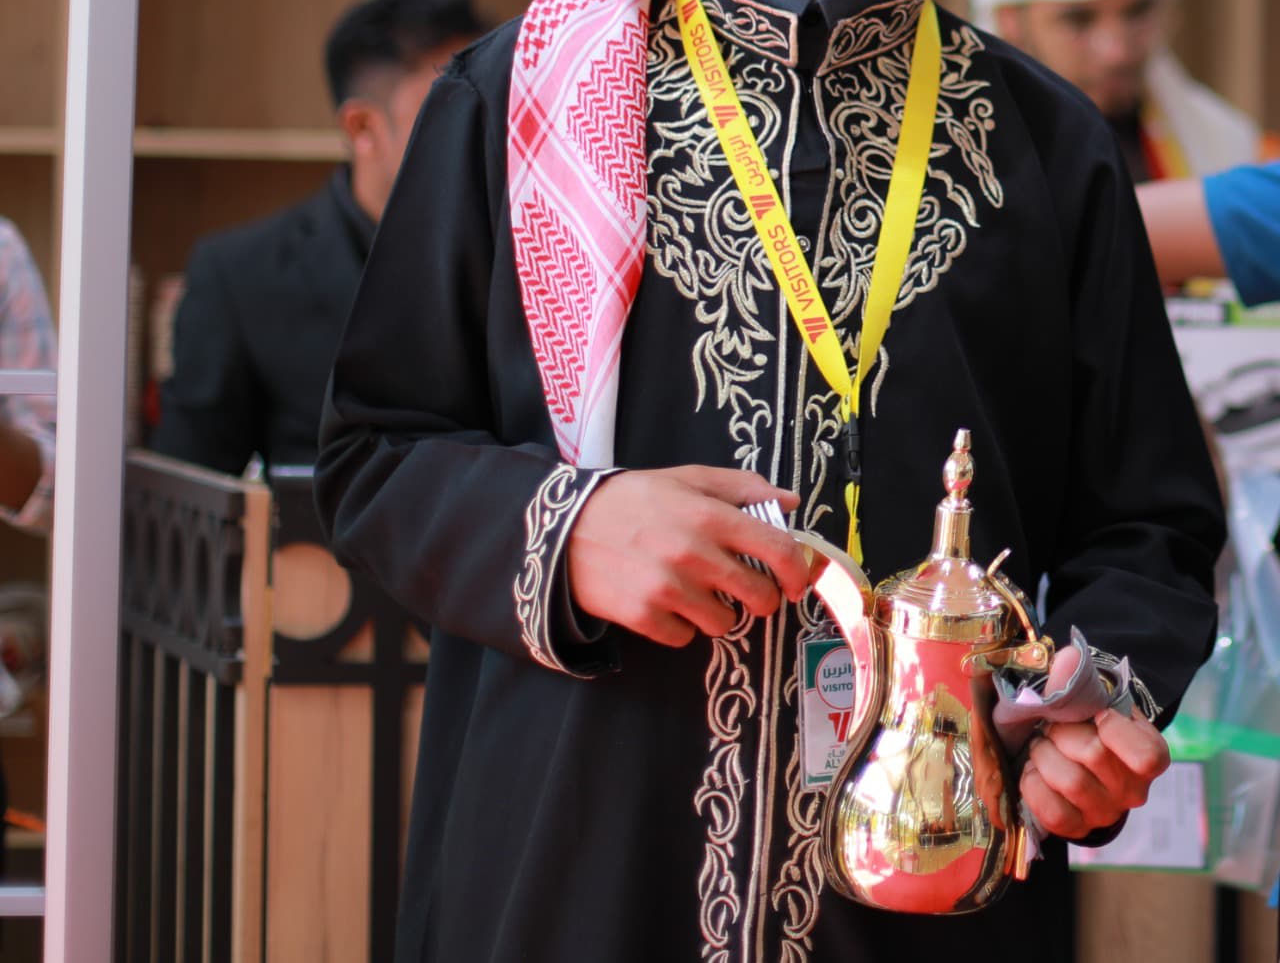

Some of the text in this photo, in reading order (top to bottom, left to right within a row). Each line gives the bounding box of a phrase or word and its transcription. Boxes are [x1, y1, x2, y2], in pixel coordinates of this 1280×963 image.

[690, 22, 726, 100] VISITORS
[728, 135, 765, 187] الزائرين
[768, 224, 815, 312] VISITORS
[822, 682, 853, 692] VISITO
